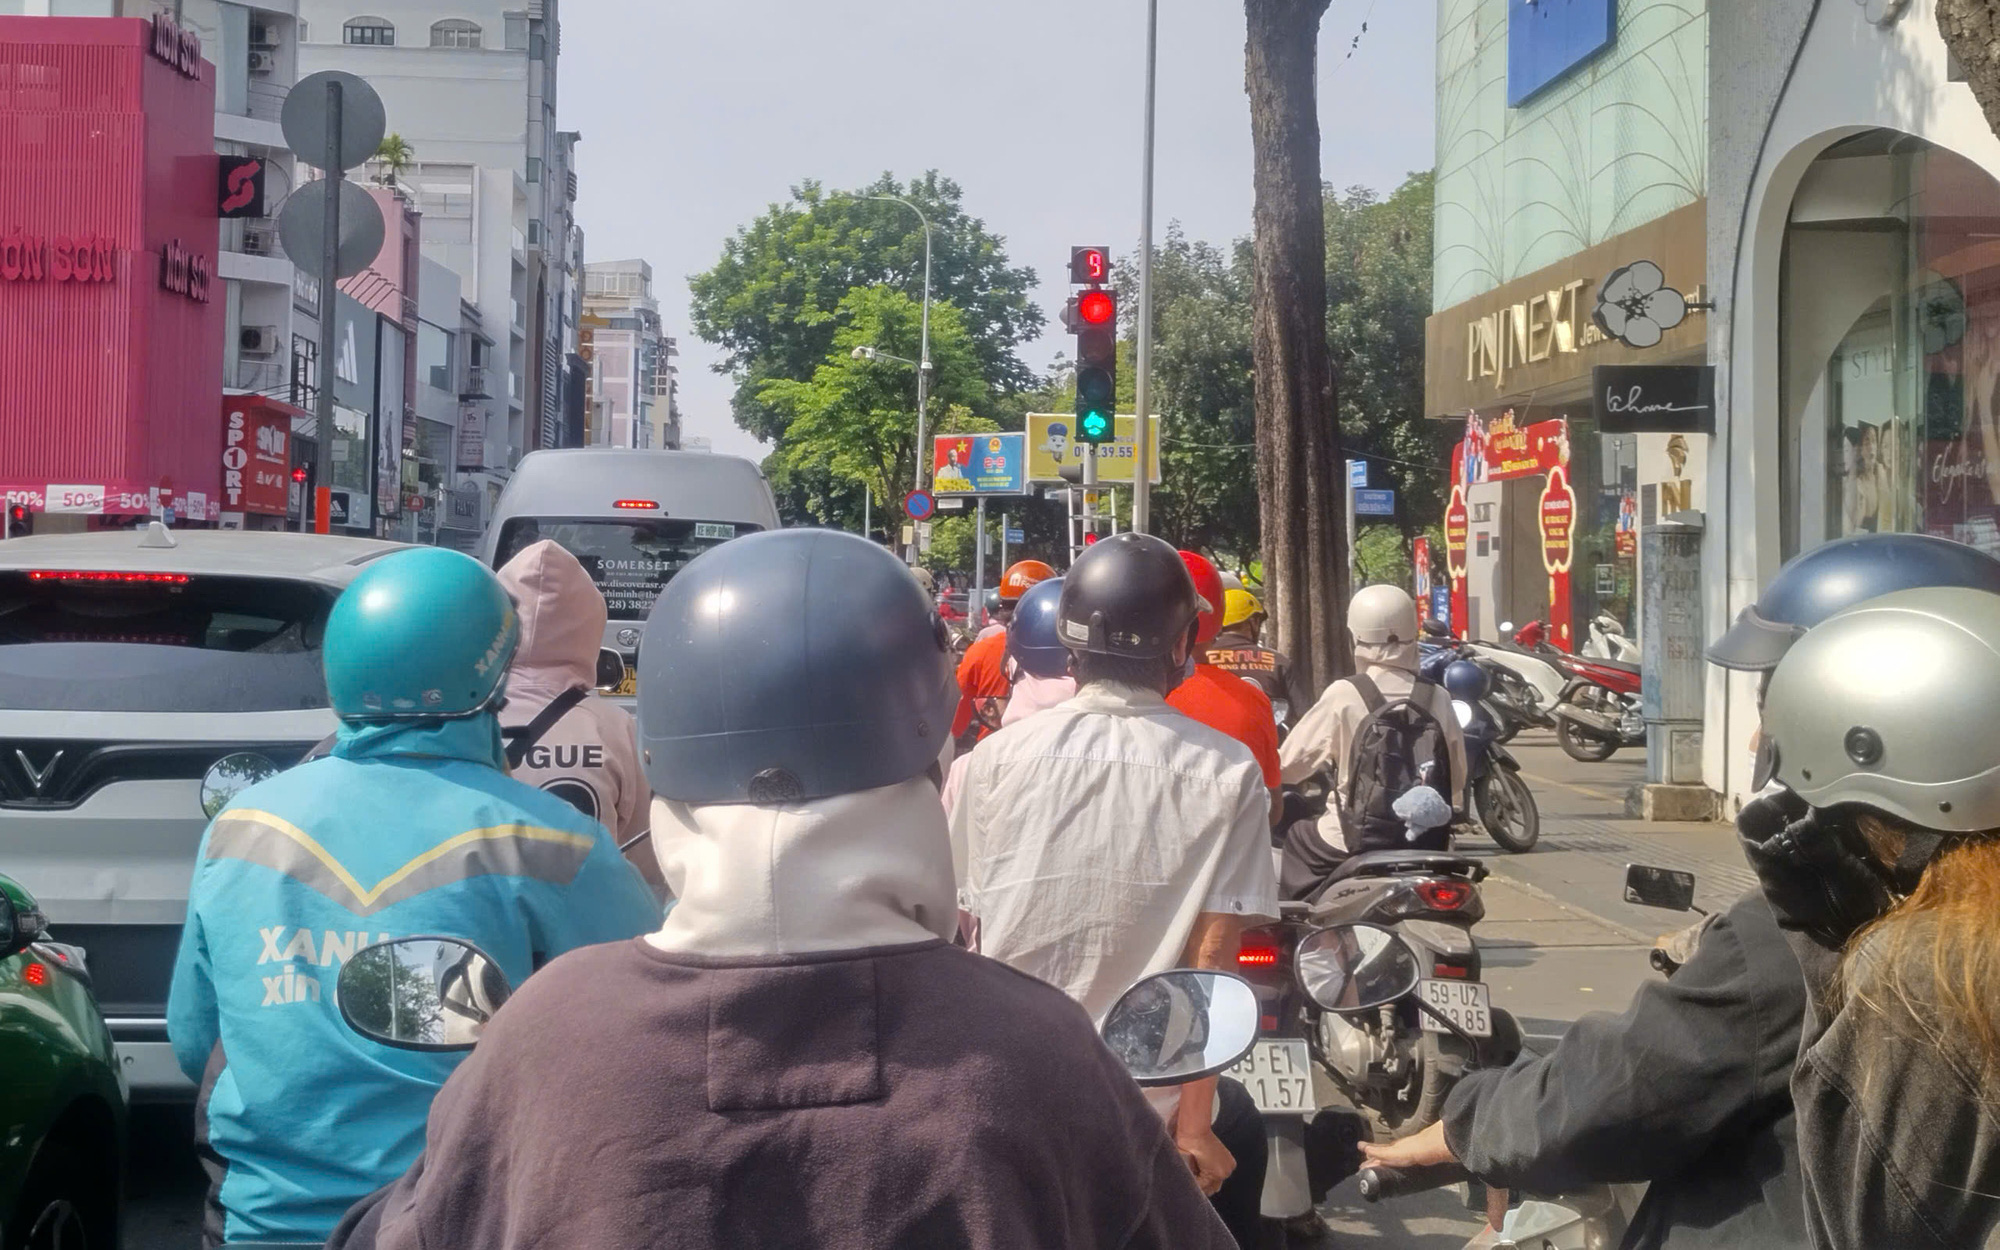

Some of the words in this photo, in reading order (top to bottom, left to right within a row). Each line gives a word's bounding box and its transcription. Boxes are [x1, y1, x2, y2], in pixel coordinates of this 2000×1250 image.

[597, 560, 670, 571] SOMERSET
[261, 964, 321, 1007] xin
[1430, 983, 1479, 1007] 59-U2
[1243, 1078, 1306, 1108] 1.57
